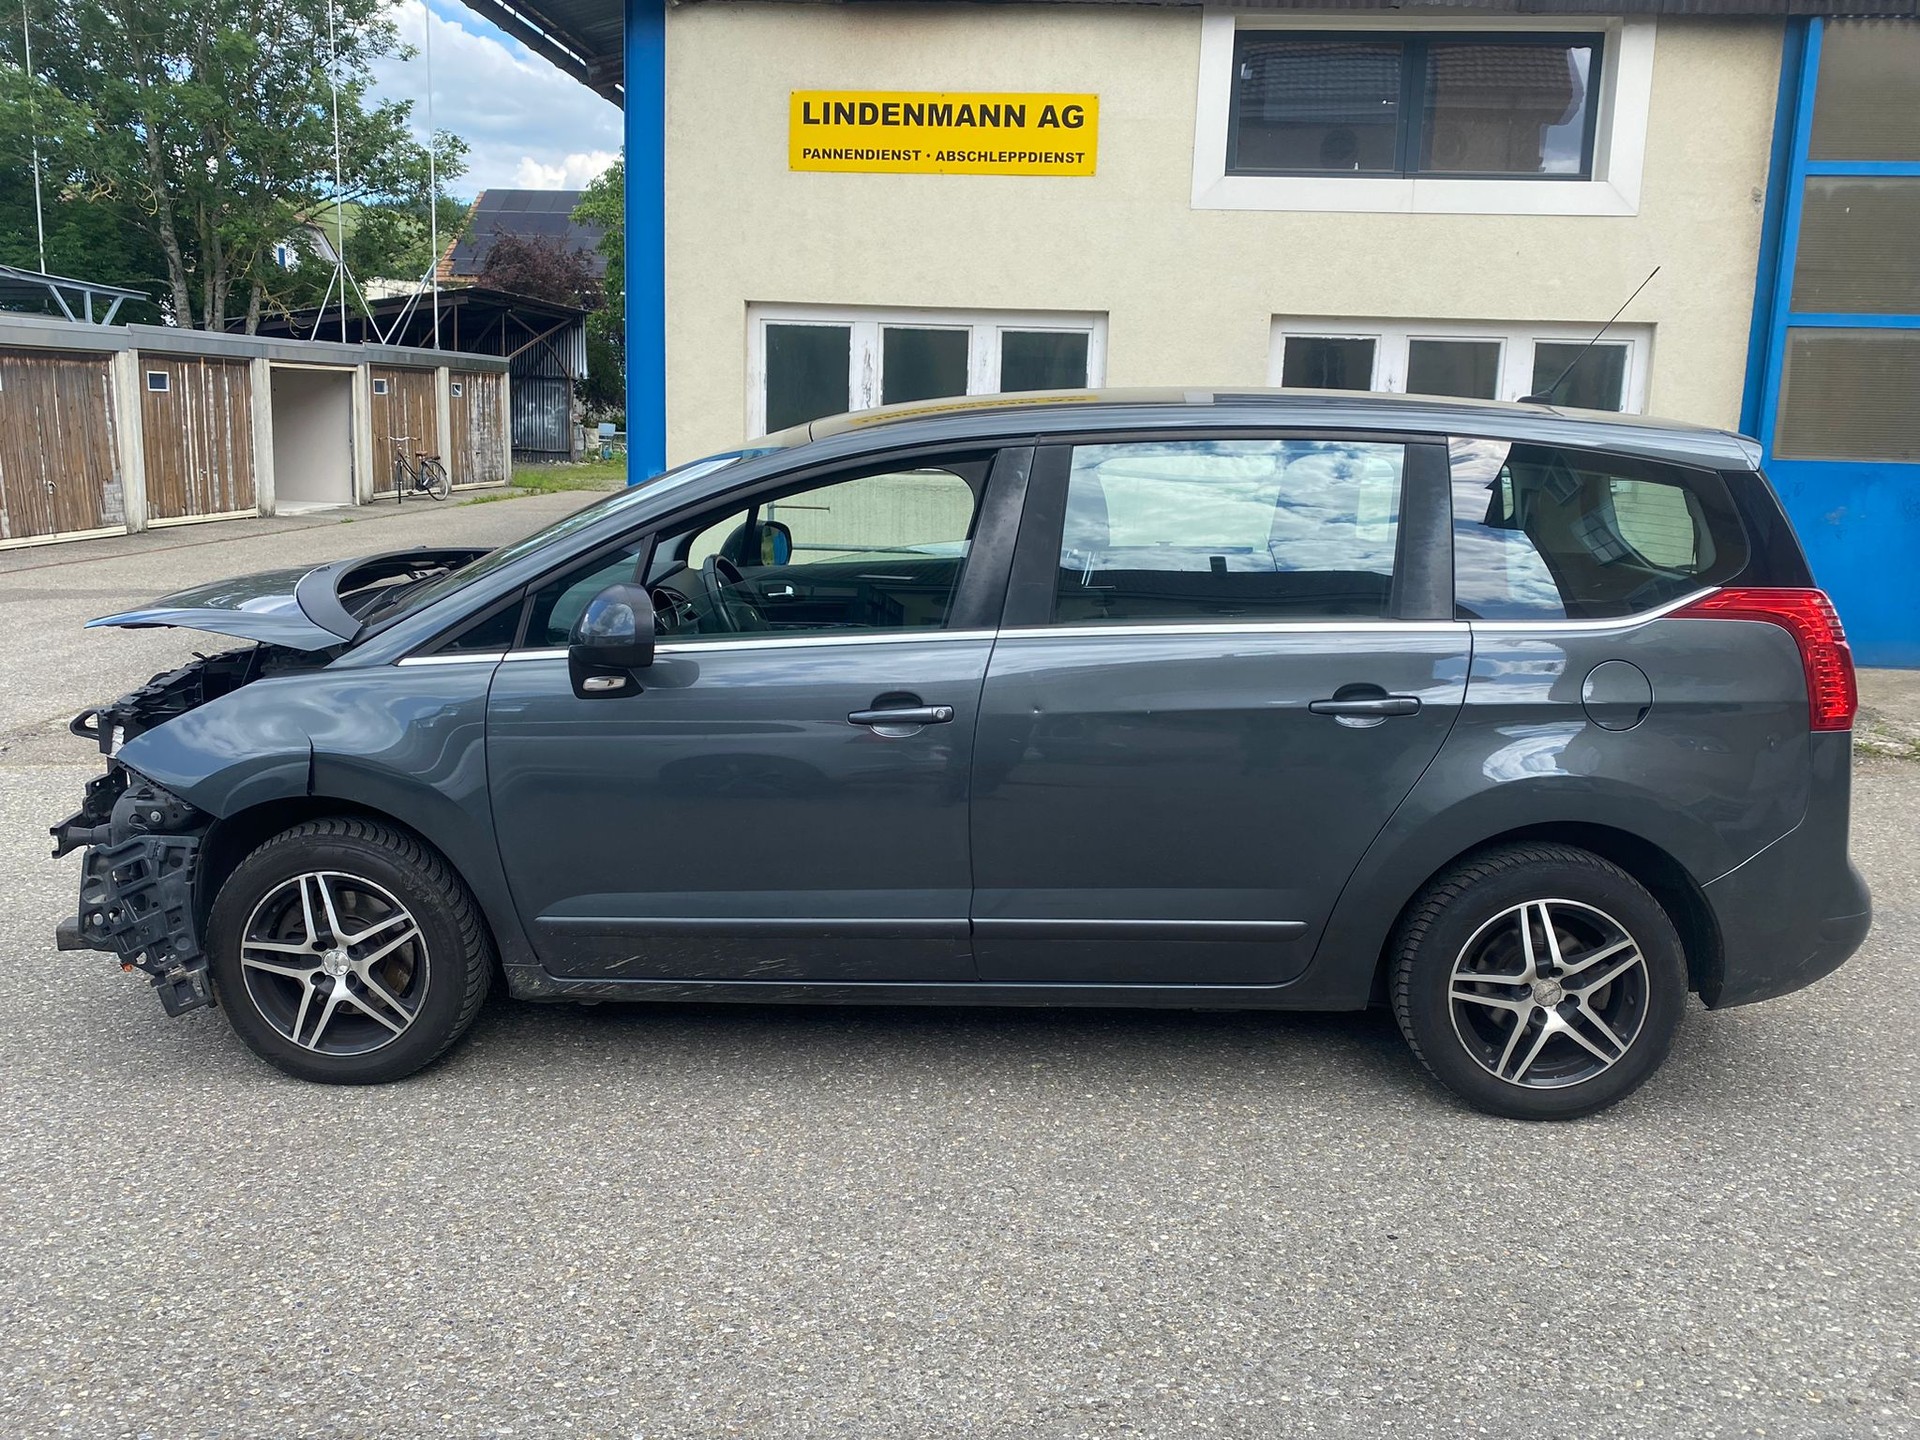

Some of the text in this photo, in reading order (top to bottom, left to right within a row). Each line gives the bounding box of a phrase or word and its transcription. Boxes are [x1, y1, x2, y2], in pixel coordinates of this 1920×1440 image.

[802, 101, 1085, 129] LINDENMANN AG
[802, 148, 1086, 164] PANNENDIENST ABSCHLEPPDIENST
